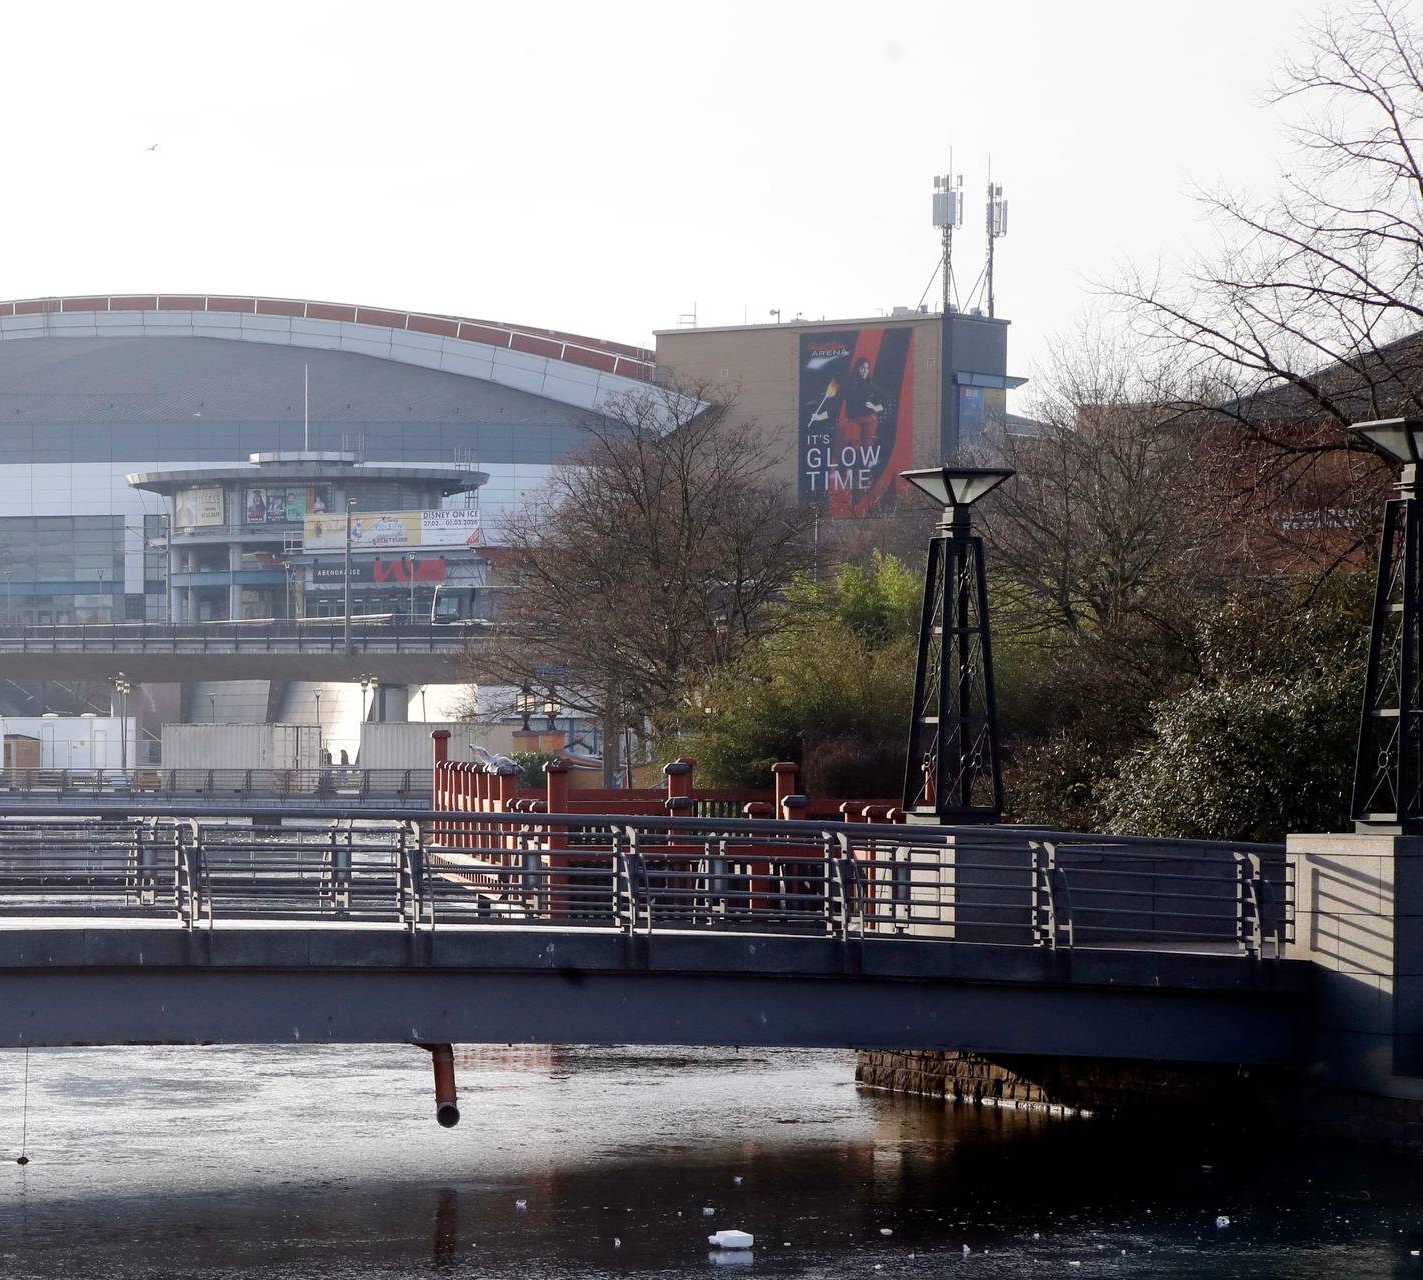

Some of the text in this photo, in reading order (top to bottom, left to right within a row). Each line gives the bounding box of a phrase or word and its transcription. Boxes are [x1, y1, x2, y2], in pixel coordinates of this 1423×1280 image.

[807, 434, 830, 445] IT'S
[806, 445, 881, 468] GLOW
[806, 469, 872, 491] TIME
[423, 510, 479, 520] DISNEY ON ICE
